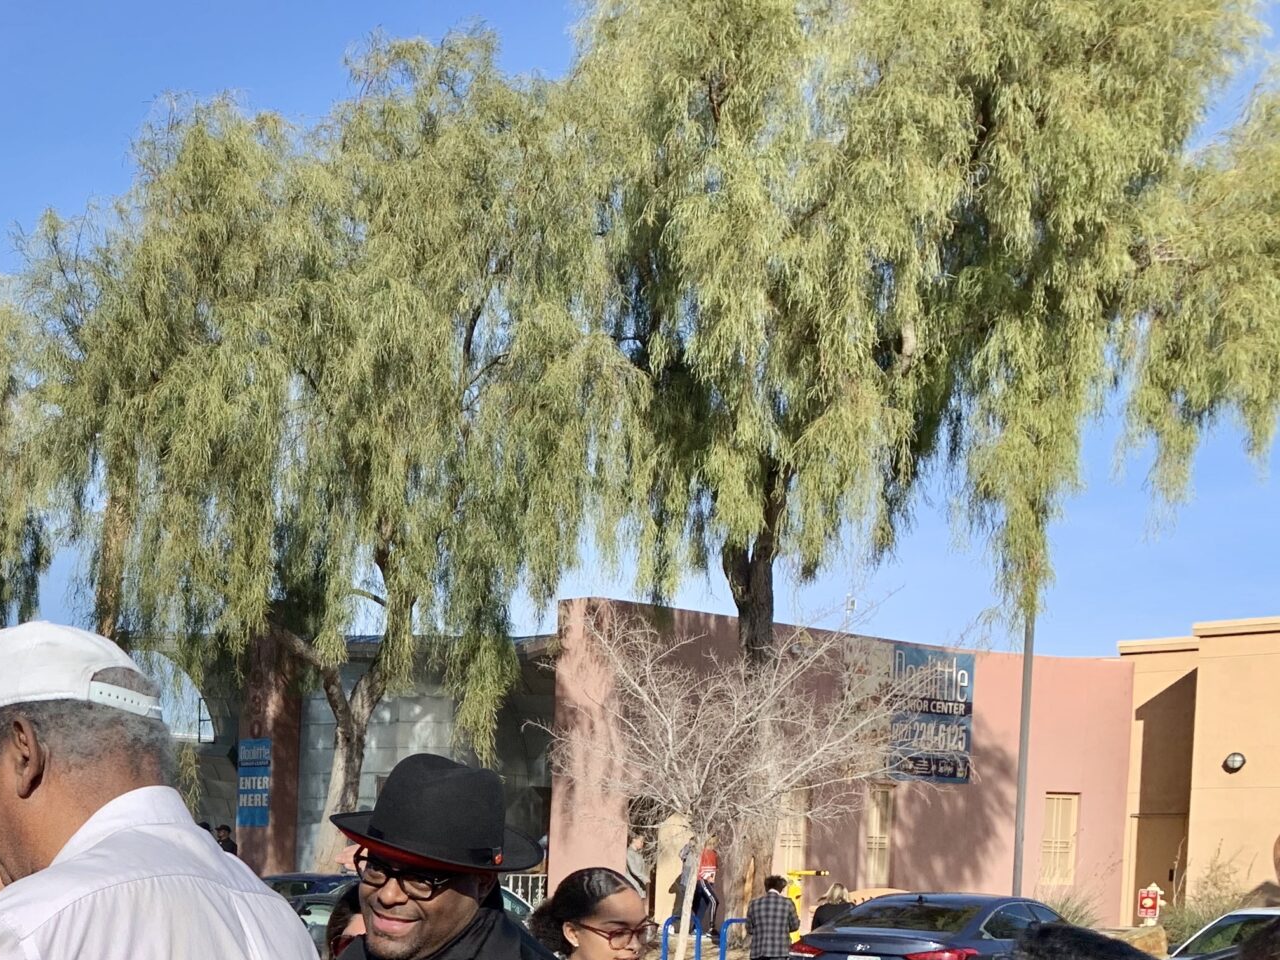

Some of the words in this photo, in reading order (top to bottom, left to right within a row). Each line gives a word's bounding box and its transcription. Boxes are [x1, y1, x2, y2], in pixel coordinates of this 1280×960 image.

[930, 701, 966, 715] CENTER
[239, 776, 269, 790] ENTER
[239, 793, 269, 807] HERE
